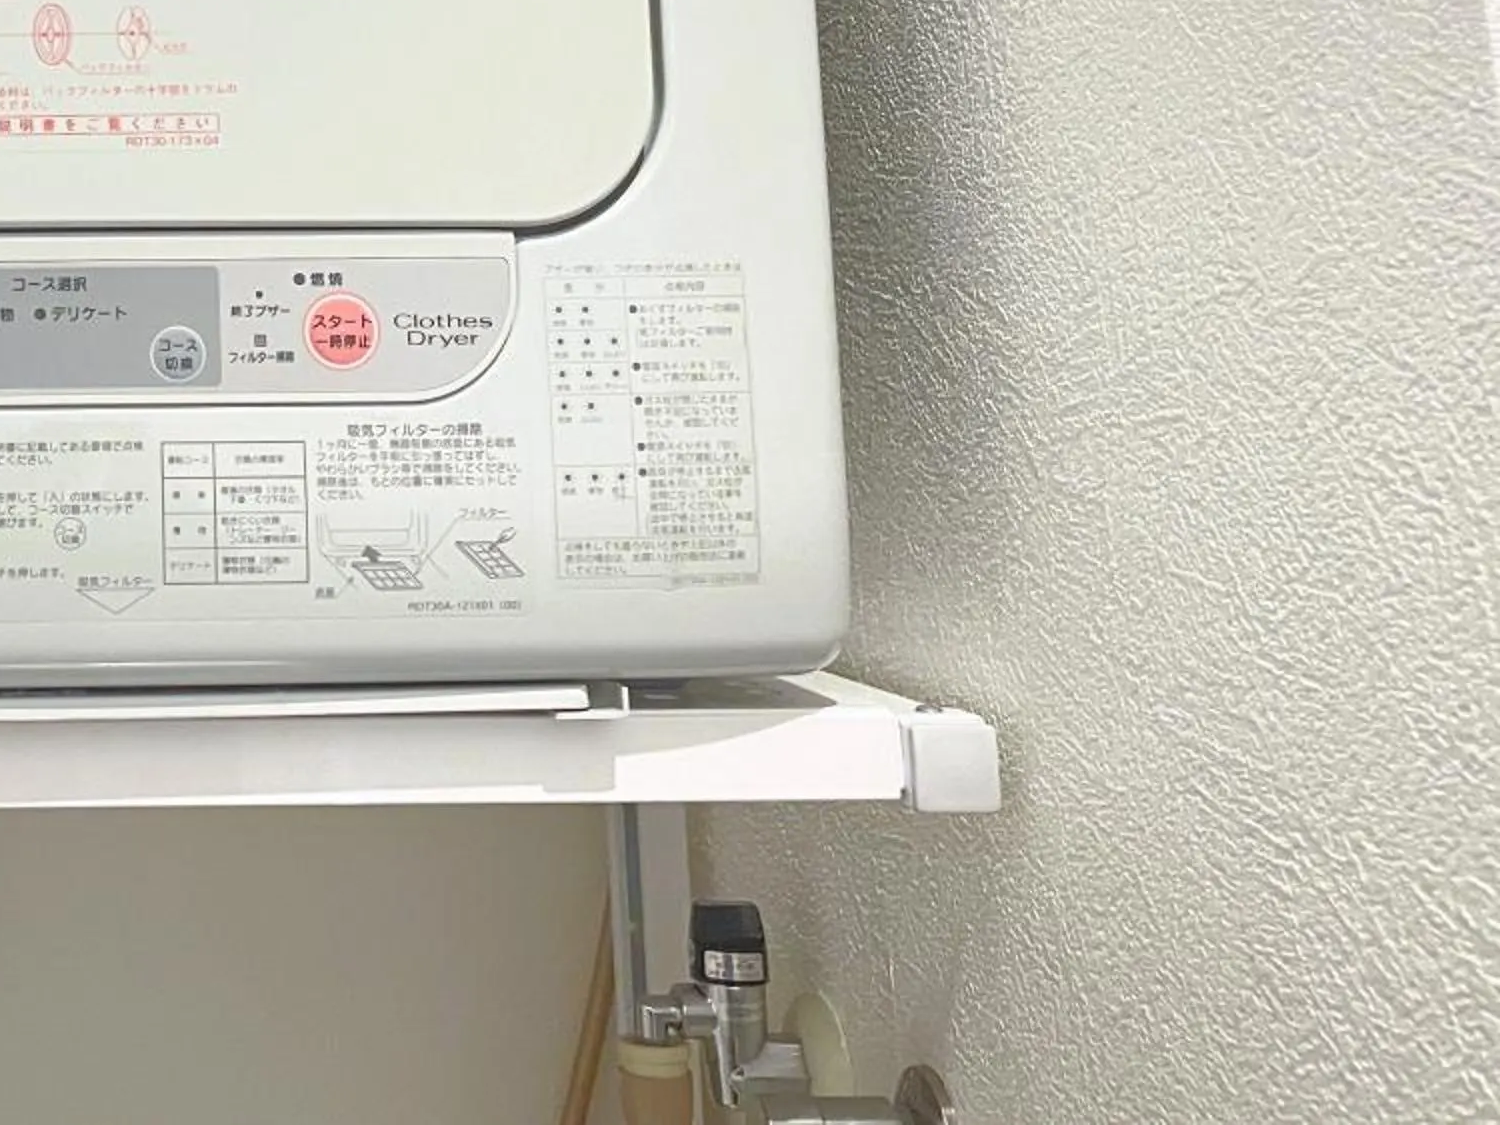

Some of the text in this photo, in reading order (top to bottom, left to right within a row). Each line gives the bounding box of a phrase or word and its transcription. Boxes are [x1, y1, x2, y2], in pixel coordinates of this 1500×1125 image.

[12, 276, 87, 292] コース選択
[50, 305, 128, 322] デリケート
[393, 313, 493, 329] Clothes
[311, 314, 372, 330] スタート
[158, 338, 197, 352] コース
[314, 334, 372, 350] 一時停止
[407, 330, 480, 349] Dryer
